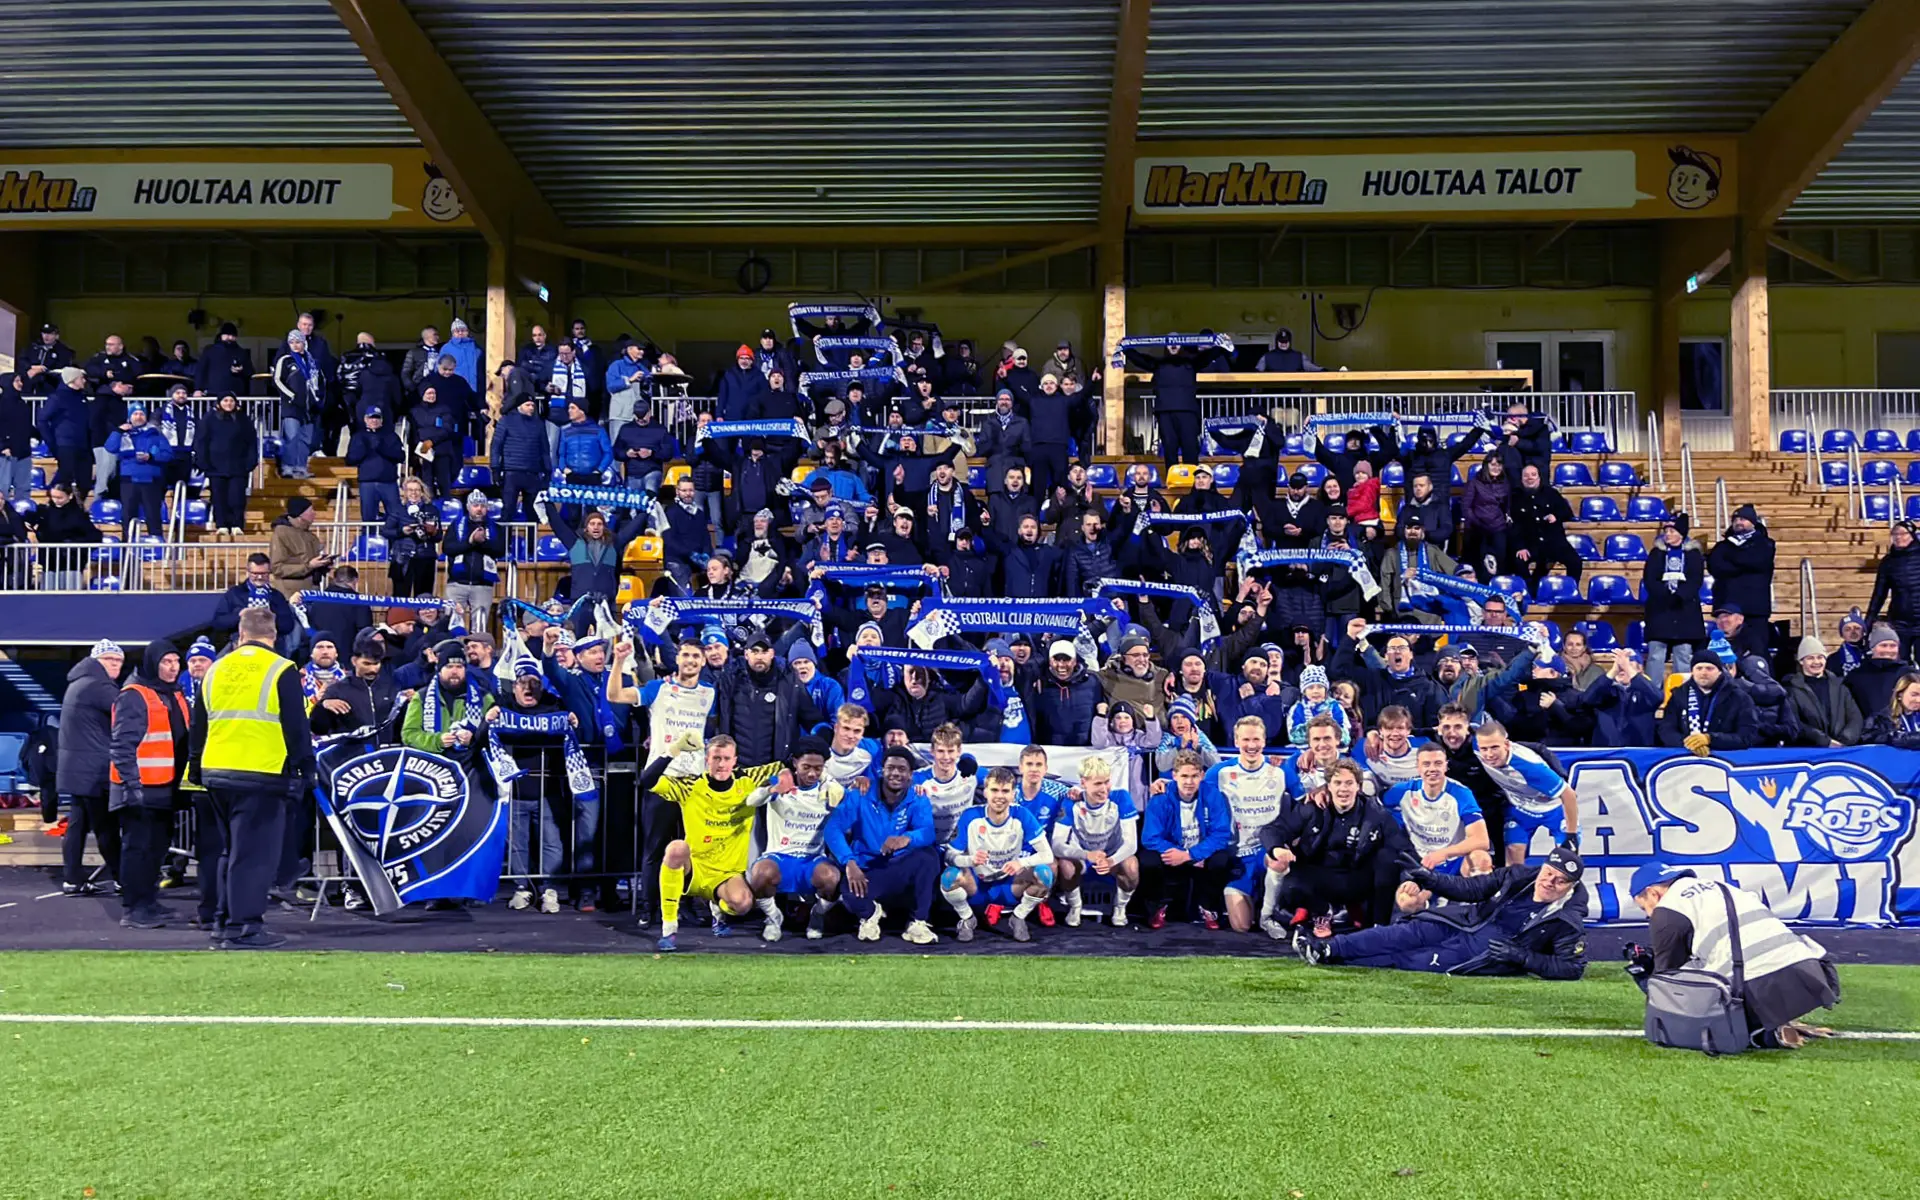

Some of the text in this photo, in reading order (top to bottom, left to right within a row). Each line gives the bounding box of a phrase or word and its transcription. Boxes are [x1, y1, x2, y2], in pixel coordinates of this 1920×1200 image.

[133, 178, 342, 205] HUOLTAA KODIT
[1361, 167, 1582, 197] HUOLTAA TALOT
[548, 486, 649, 506] ROVANIEMI
[941, 597, 1085, 605] ROVANIEMEN PALLOSEURA
[960, 611, 1079, 630] FOOTBALL CLUB ROVANIEMI
[856, 649, 982, 667] ANIEMEN PALLOSEURA
[519, 715, 550, 731] CLUB
[336, 758, 385, 798] ULTRAS
[1232, 804, 1276, 815] Terveystalo
[1782, 799, 1901, 834] RoPS
[398, 809, 452, 850] ULTRAS
